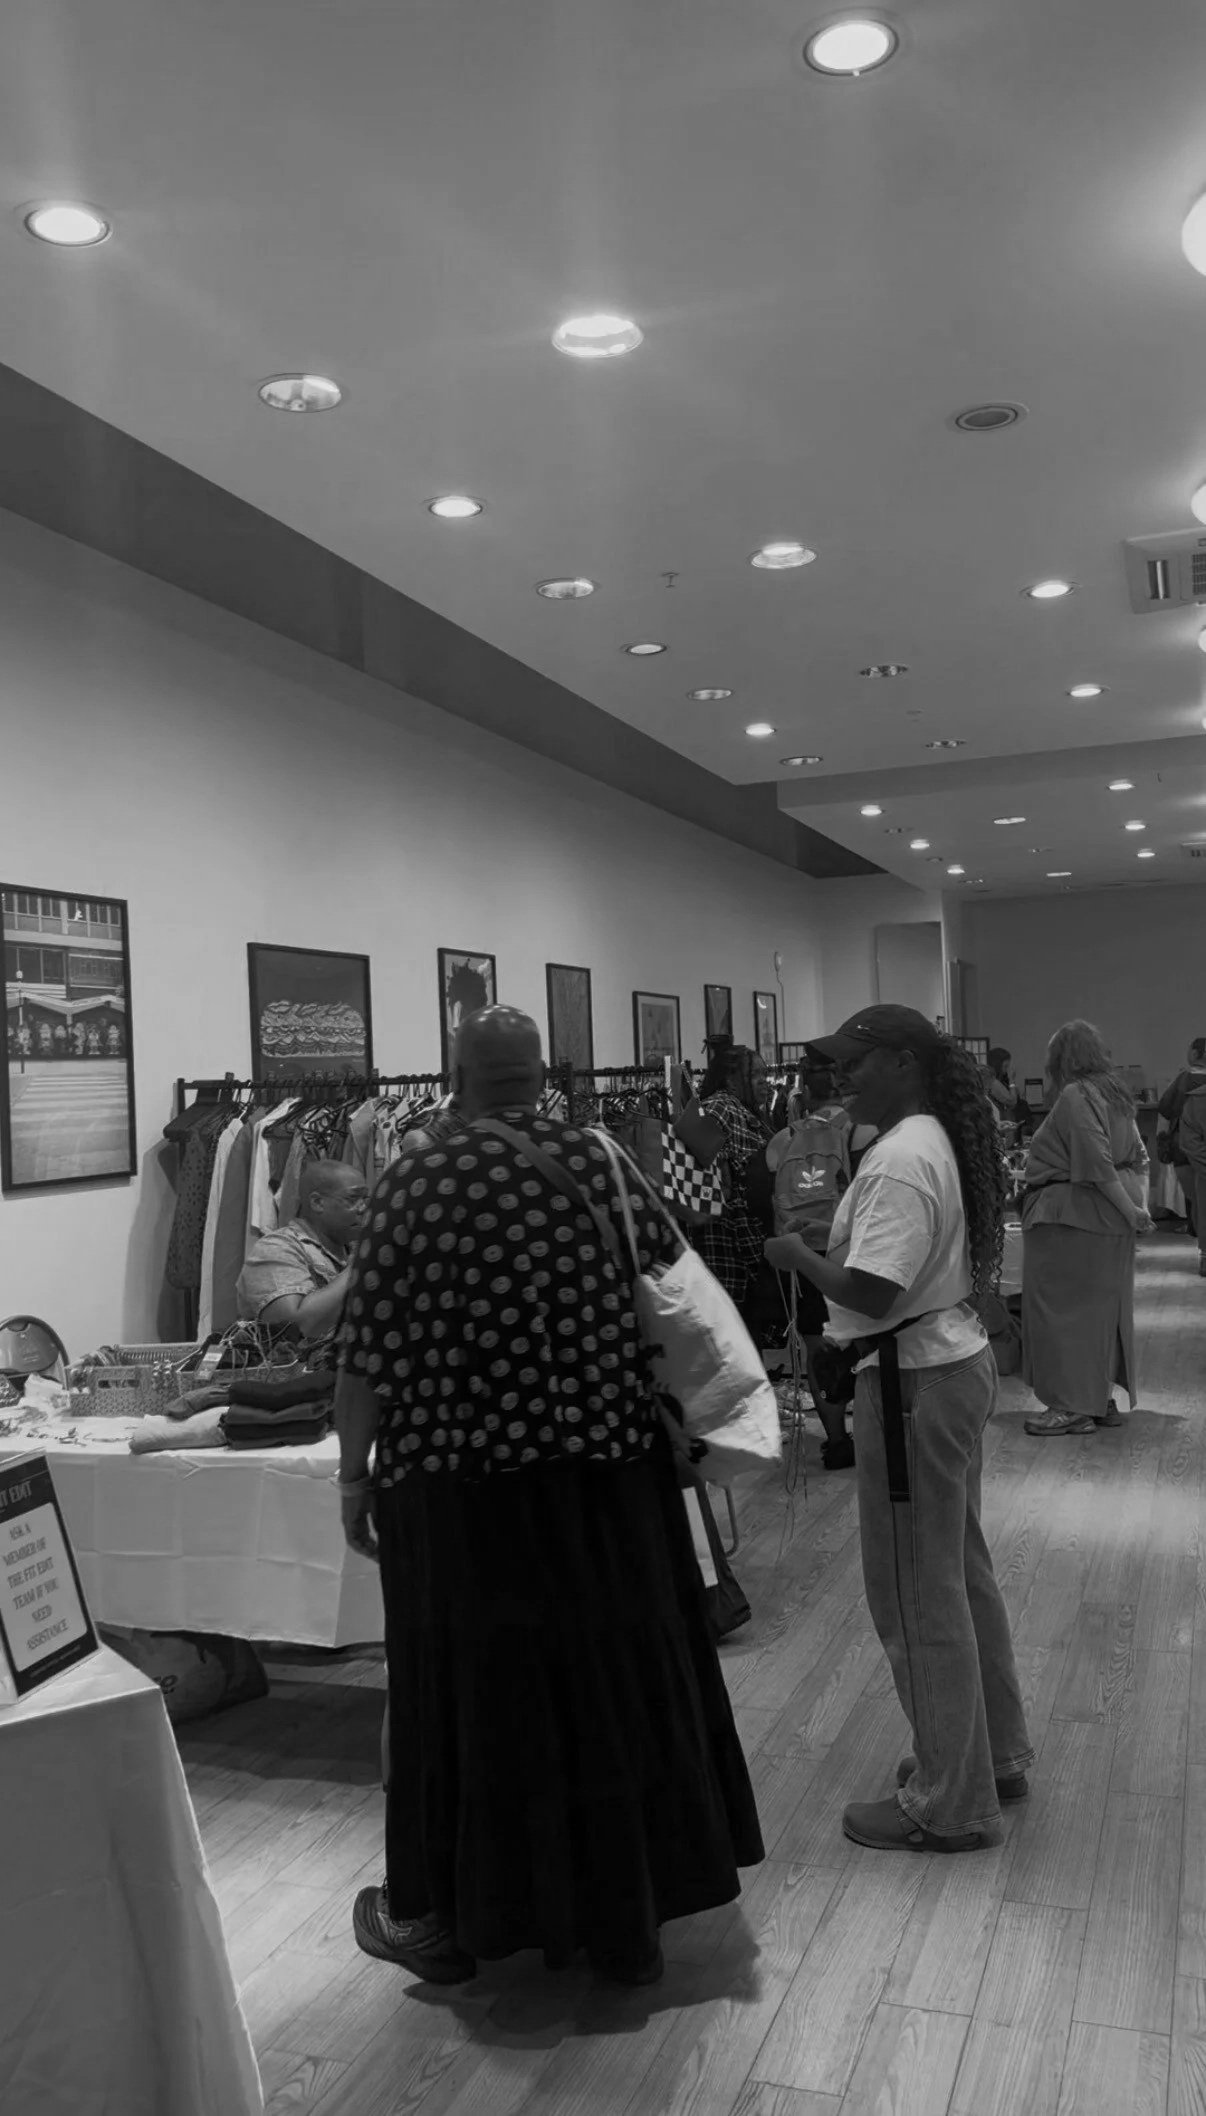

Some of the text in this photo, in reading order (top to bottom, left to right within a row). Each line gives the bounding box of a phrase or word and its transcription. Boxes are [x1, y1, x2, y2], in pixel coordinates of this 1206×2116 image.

[3, 1542, 36, 1565] MEMBER
[8, 1556, 54, 1588] THE FIT EDIT
[13, 1588, 35, 1609] TEAM
[27, 1618, 69, 1650] ASSISTANCE
